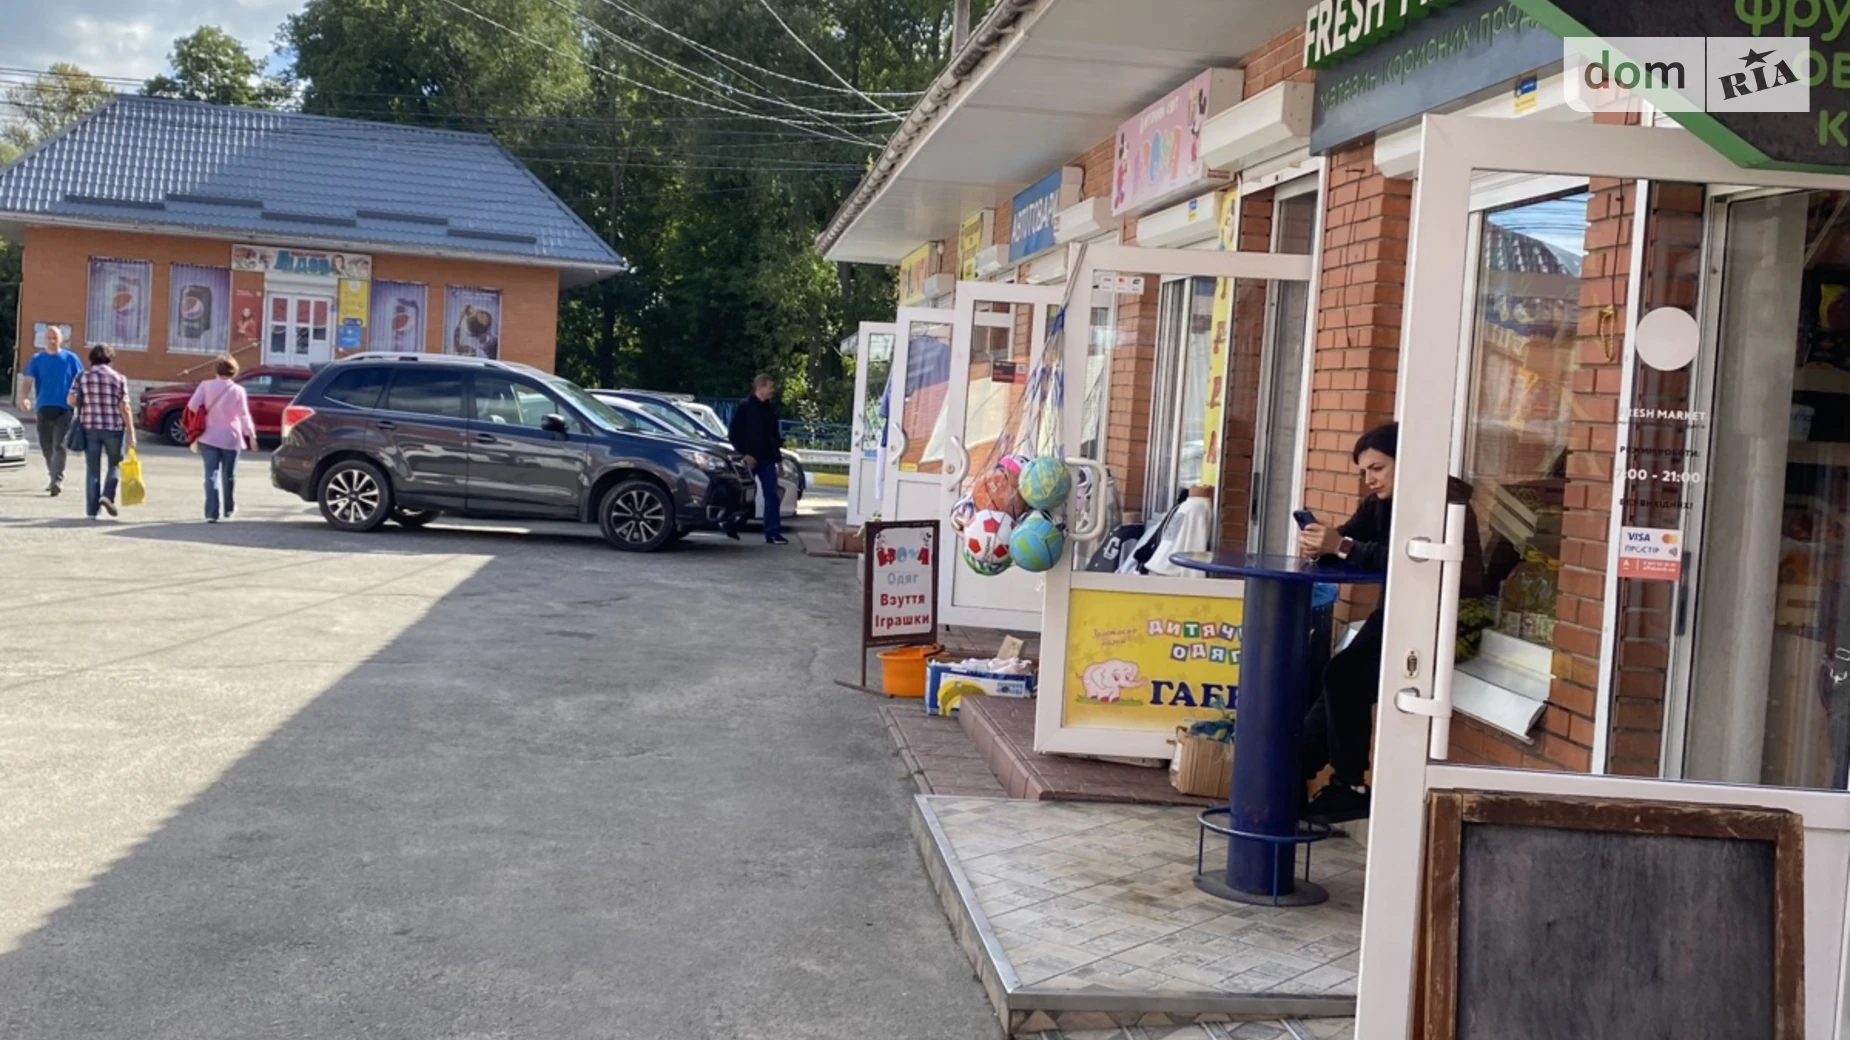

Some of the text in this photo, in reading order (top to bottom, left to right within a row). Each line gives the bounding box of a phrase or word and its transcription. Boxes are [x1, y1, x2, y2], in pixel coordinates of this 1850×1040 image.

[1302, 0, 1387, 68] FRESH
[1381, 22, 1471, 86] корисних
[1657, 409, 1706, 420] MARKET
[1662, 470, 1700, 483] 21:00
[1628, 532, 1650, 542] VISA
[1624, 545, 1659, 553] ПРОСТІР
[887, 572, 919, 586] Одяг
[880, 593, 926, 608] Взуття
[875, 614, 930, 630] Іграшки
[1148, 620, 1243, 641] ДИТЯЧ
